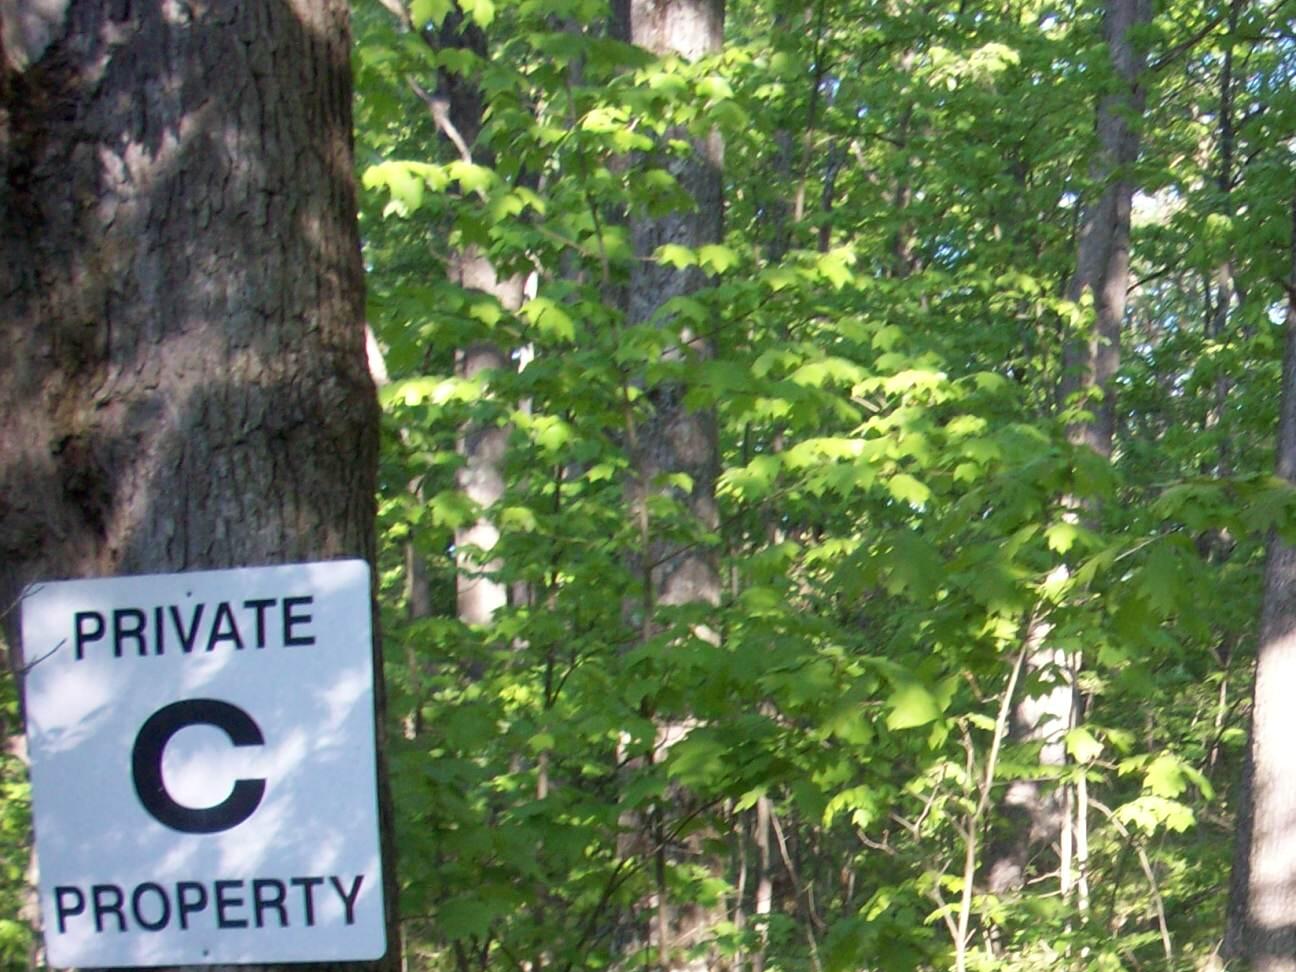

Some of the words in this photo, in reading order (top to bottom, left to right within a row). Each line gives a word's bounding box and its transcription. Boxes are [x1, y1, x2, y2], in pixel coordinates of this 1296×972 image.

[73, 595, 316, 660] PRIVATE
[131, 697, 267, 835] C
[53, 874, 365, 934] PROPERTY
